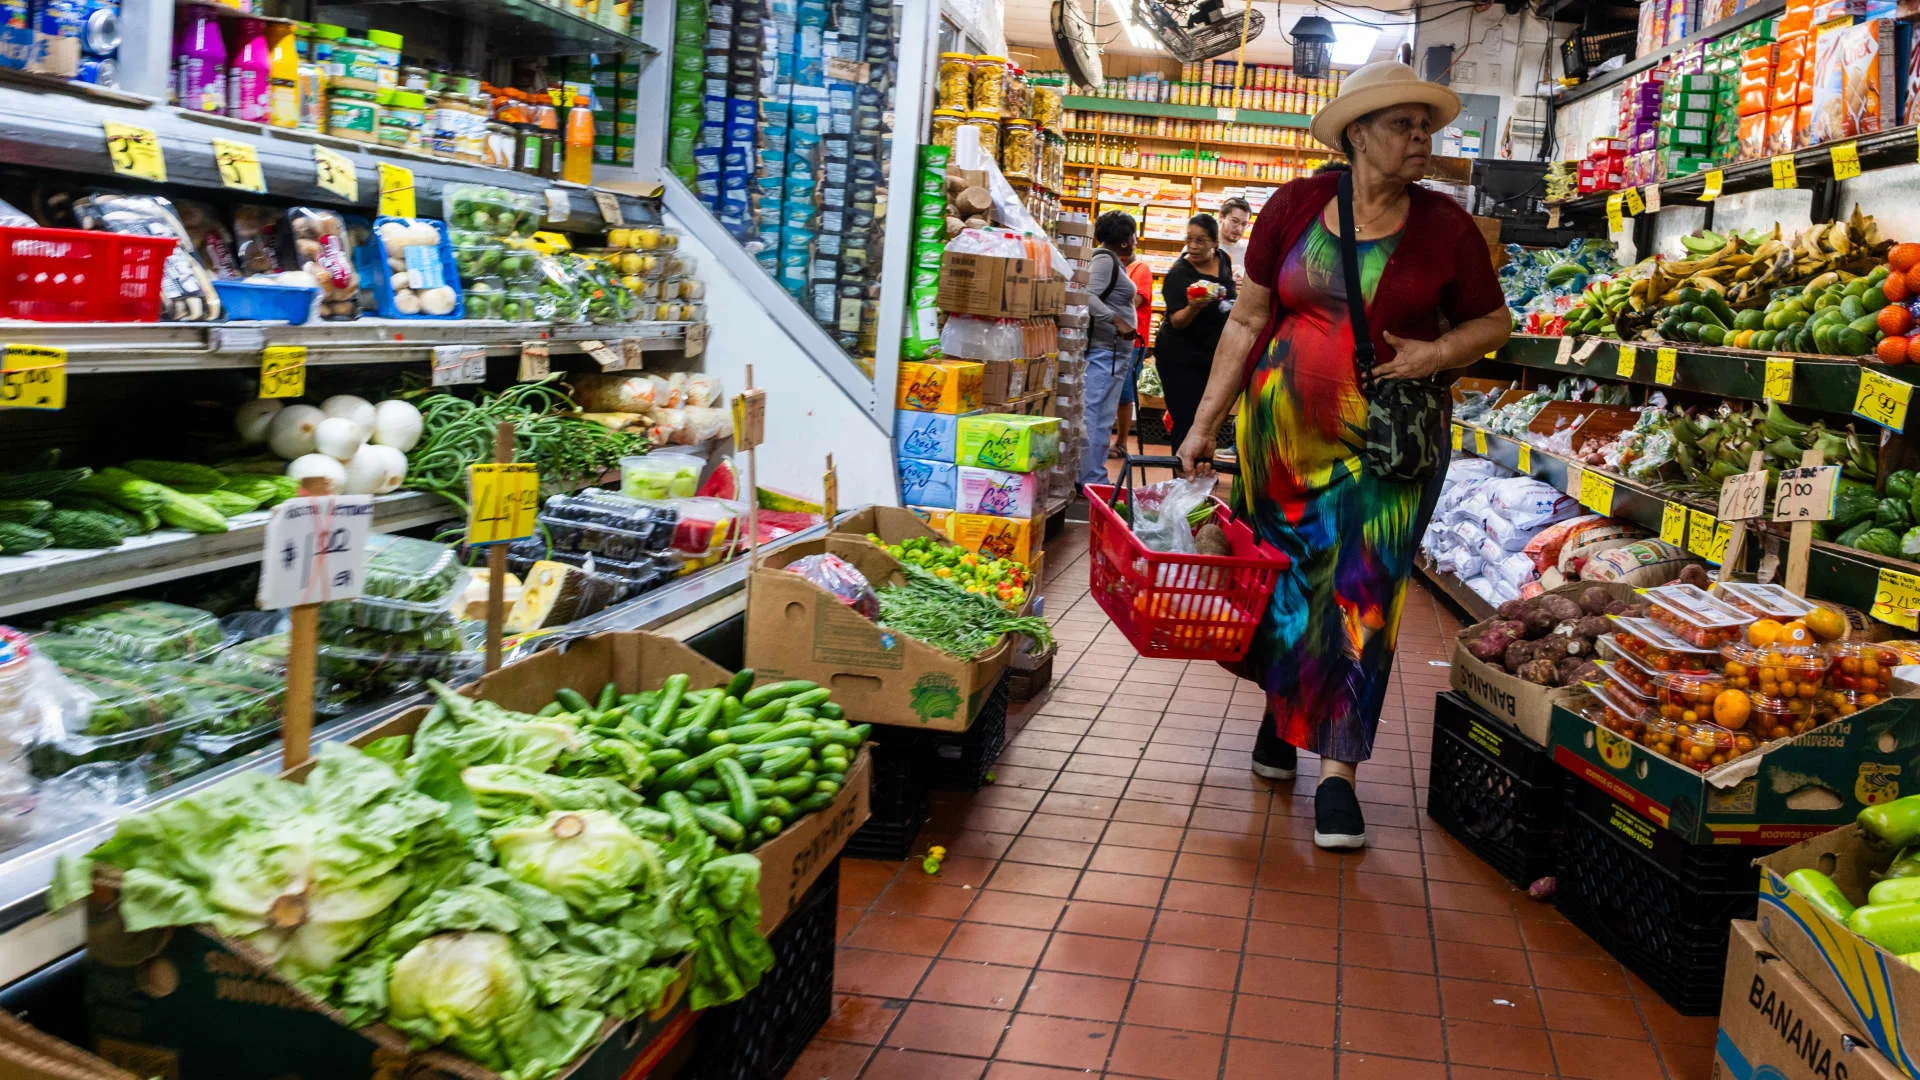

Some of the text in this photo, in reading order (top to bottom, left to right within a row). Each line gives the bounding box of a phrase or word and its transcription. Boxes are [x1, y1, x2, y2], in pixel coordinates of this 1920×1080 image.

[922, 418, 938, 436] La
[996, 428, 1013, 446] La
[904, 430, 942, 456] Croix
[1460, 663, 1516, 717] BANANAS
[1748, 974, 1849, 1080] BANANAS
